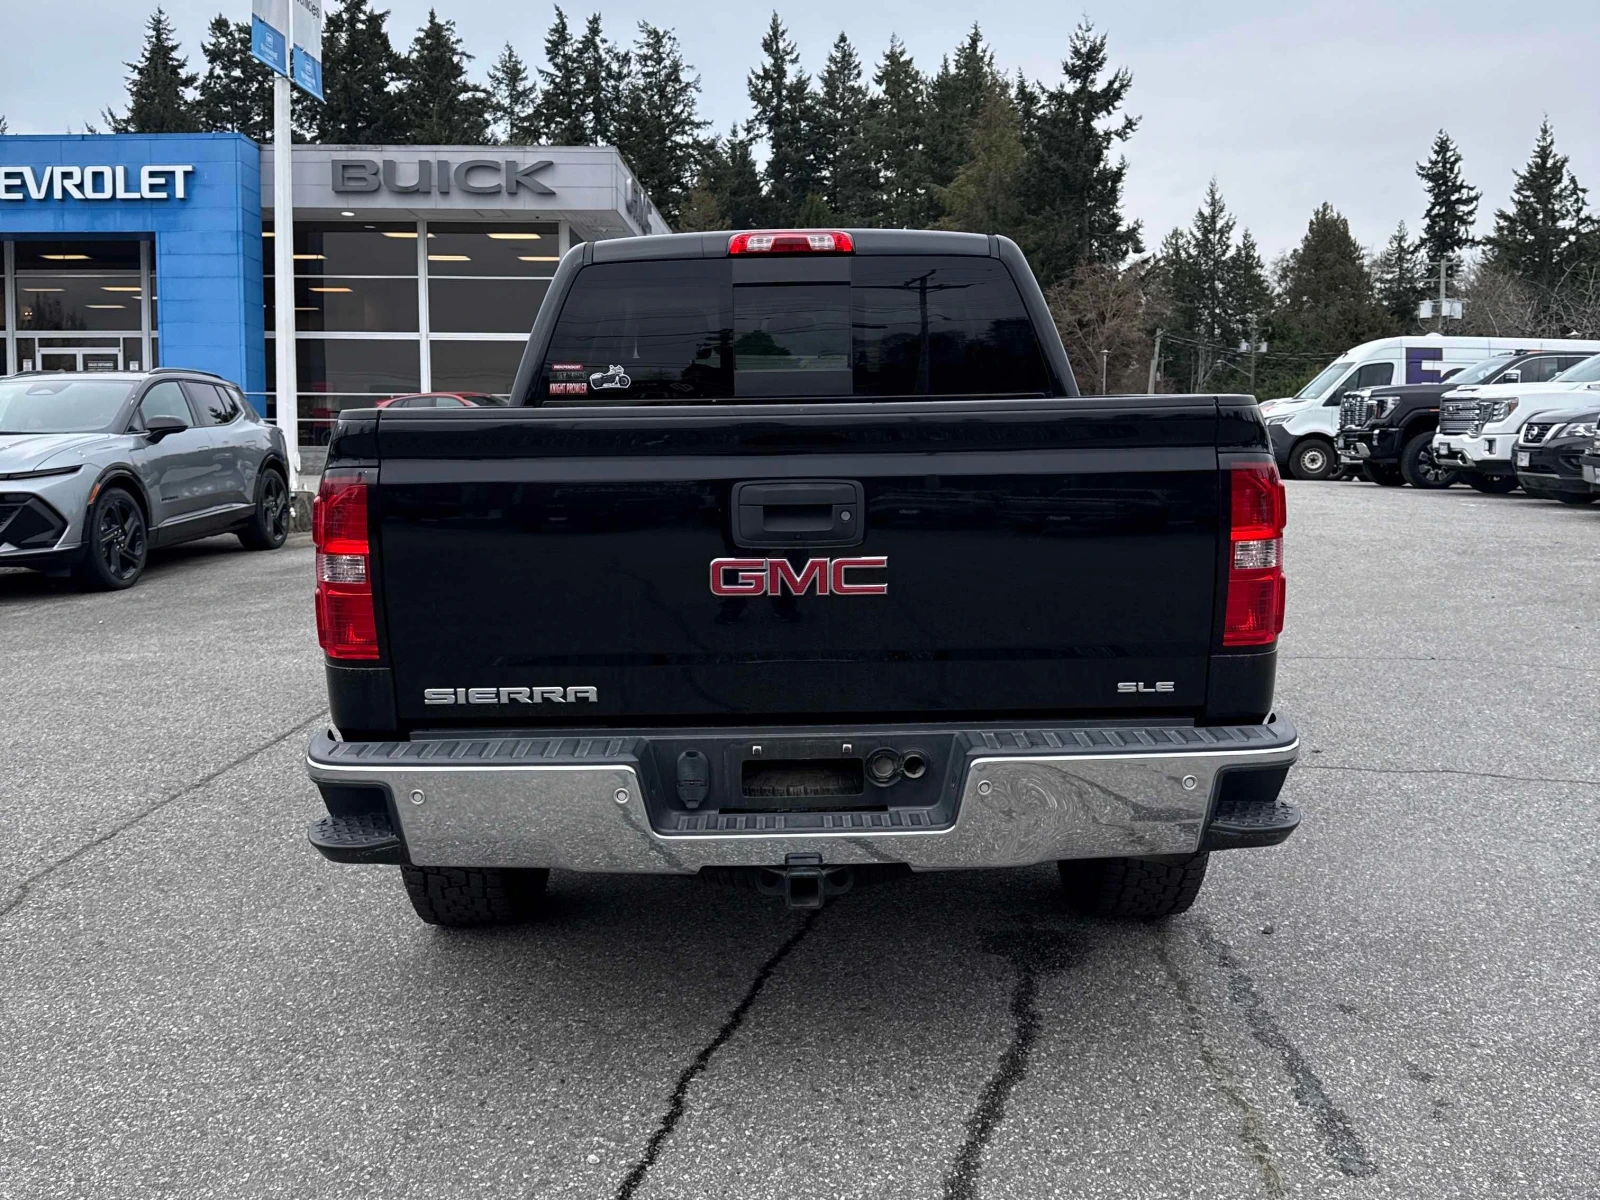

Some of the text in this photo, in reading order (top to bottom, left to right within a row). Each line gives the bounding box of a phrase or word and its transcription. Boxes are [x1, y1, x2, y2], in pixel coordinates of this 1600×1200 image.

[0, 165, 194, 200] EVROLET
[331, 159, 557, 194] BUICK
[549, 383, 566, 394] KNIGHT
[710, 556, 888, 596] GMC
[424, 686, 598, 705] SIERRA
[1117, 681, 1175, 693] SLE
